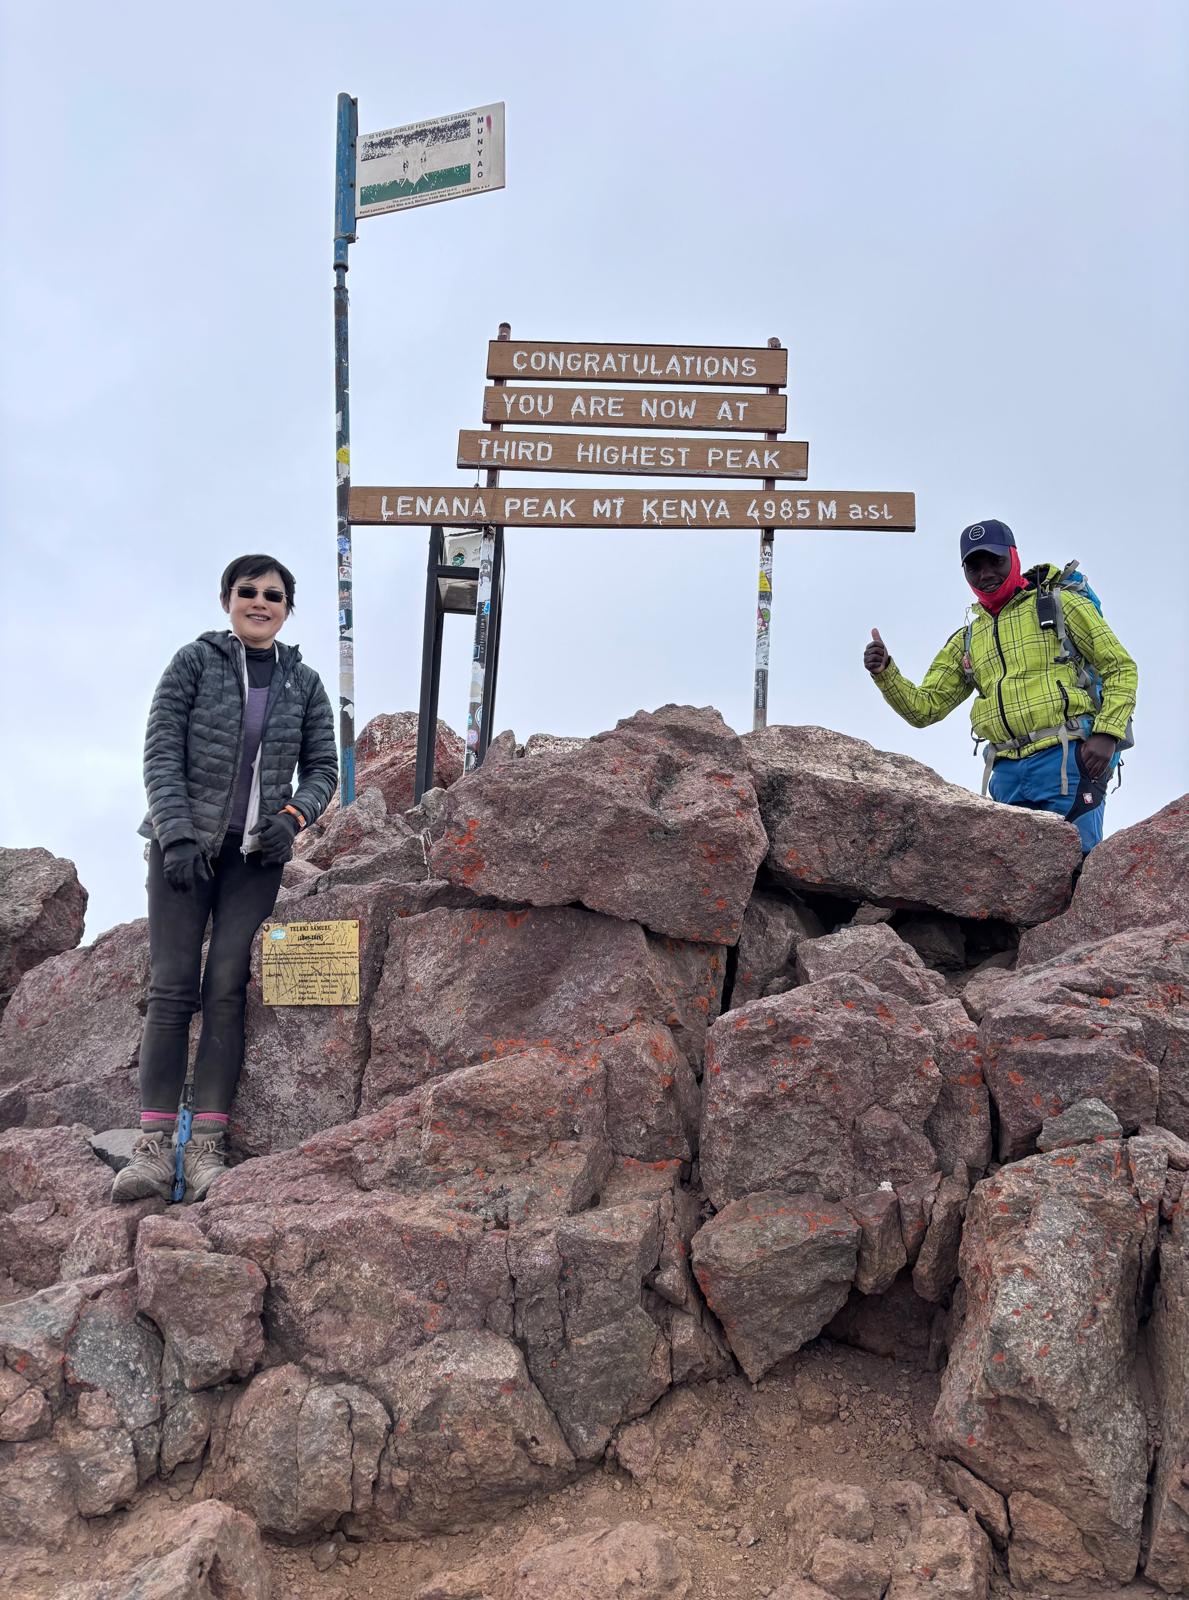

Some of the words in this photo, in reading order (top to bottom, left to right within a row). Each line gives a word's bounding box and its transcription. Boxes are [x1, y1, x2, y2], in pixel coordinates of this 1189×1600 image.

[416, 119, 439, 129] FESTIVAL
[441, 112, 477, 122] CELEBRATION
[512, 350, 757, 378] CONGRATULATIONS
[502, 393, 553, 418] YOU
[571, 396, 624, 418] ARE
[641, 398, 697, 420] NOW
[716, 400, 748, 421] AT
[478, 438, 552, 462] THIRD
[577, 442, 690, 467] HIGHEST
[707, 448, 780, 469] PEAK
[381, 495, 487, 521] LENANA
[504, 497, 576, 519] PEAK
[593, 496, 625, 519] MT
[641, 498, 730, 525] KENYA
